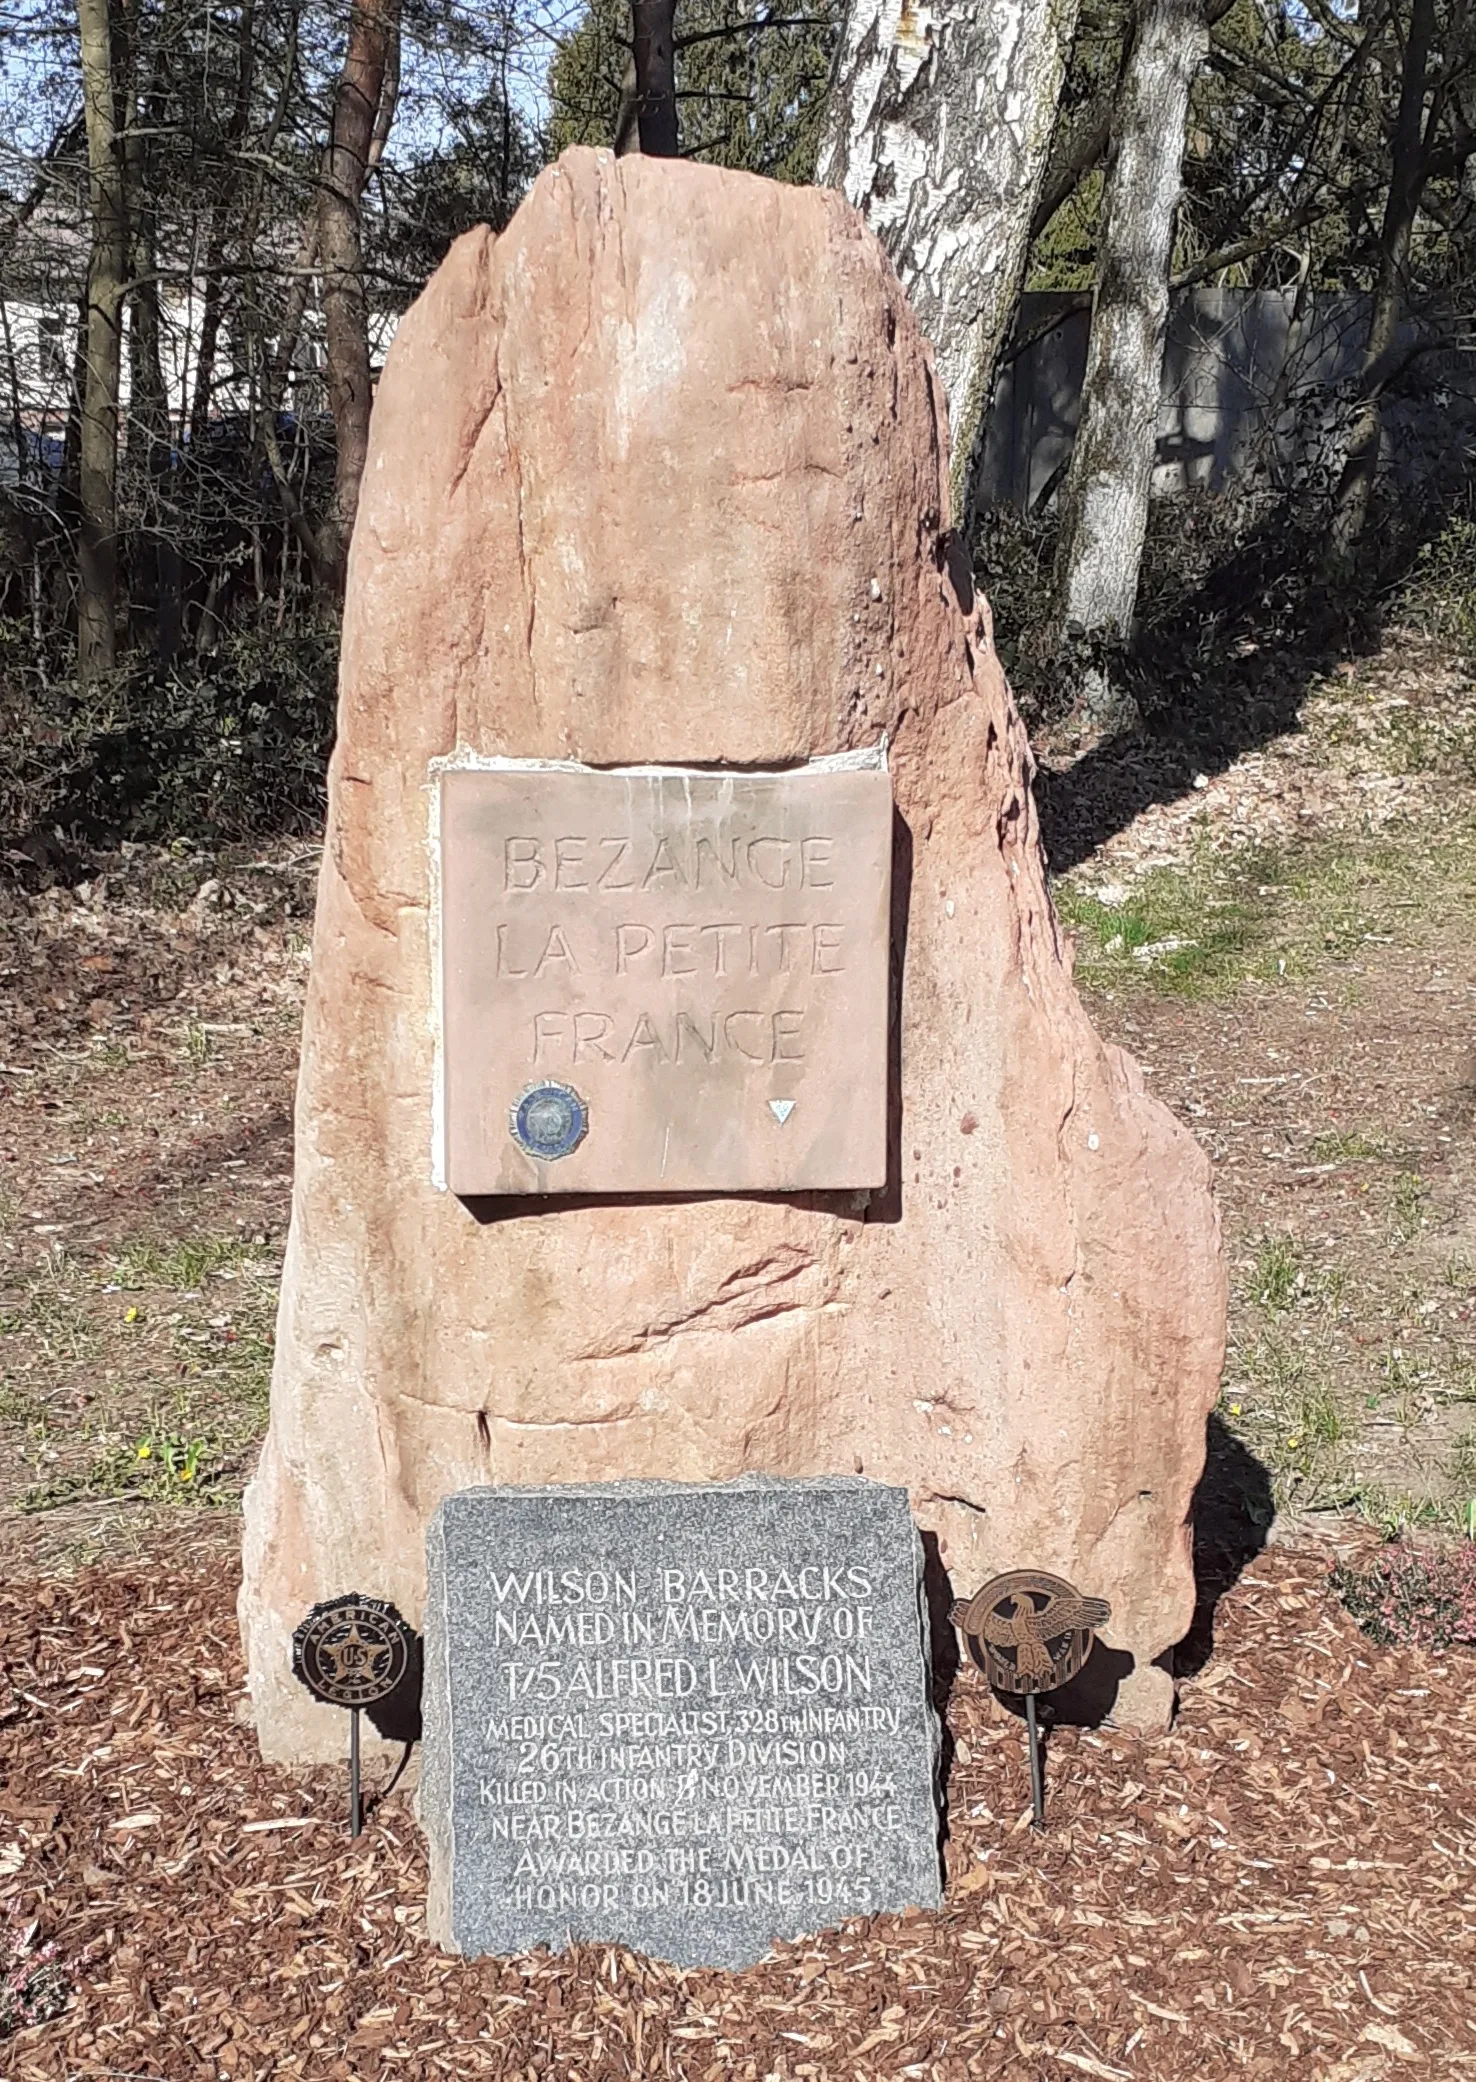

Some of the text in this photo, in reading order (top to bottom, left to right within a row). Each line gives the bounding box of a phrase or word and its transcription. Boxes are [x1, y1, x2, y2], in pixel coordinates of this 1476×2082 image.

[503, 836, 835, 892] BEZANGE
[495, 922, 846, 978] LA PETITE
[532, 1010, 806, 1064] FRANCE
[490, 1566, 872, 1605] WILSON BARRACKS
[309, 1609, 401, 1646] AMERICAN
[495, 1604, 873, 1647] NAMED IN MEMORY OF
[317, 1678, 394, 1701] LEGION
[501, 1660, 562, 1701] T/5
[566, 1659, 697, 1699] ALFRED
[735, 1654, 872, 1698] WILSON
[486, 1714, 591, 1742] MEDICAL
[802, 1706, 900, 1735] INFANTRY
[518, 1738, 845, 1774] 26TH INFANTRY DIVISION
[479, 1778, 547, 1806] KILLED
[555, 1780, 577, 1804] IN
[585, 1777, 666, 1803] ACTION
[701, 1772, 839, 1800] NOVEMBER
[846, 1769, 898, 1798] 1944
[492, 1815, 561, 1841] NEAR
[567, 1809, 687, 1839] BEZANGE
[694, 1811, 721, 1835] LA
[807, 1804, 901, 1836] FRANCE
[514, 1844, 870, 1878] AWARDED THE MEDAL OF
[514, 1881, 619, 1910] HONOR
[633, 1877, 669, 1907] ON
[681, 1877, 711, 1908] 18
[803, 1875, 873, 1905] 1945
